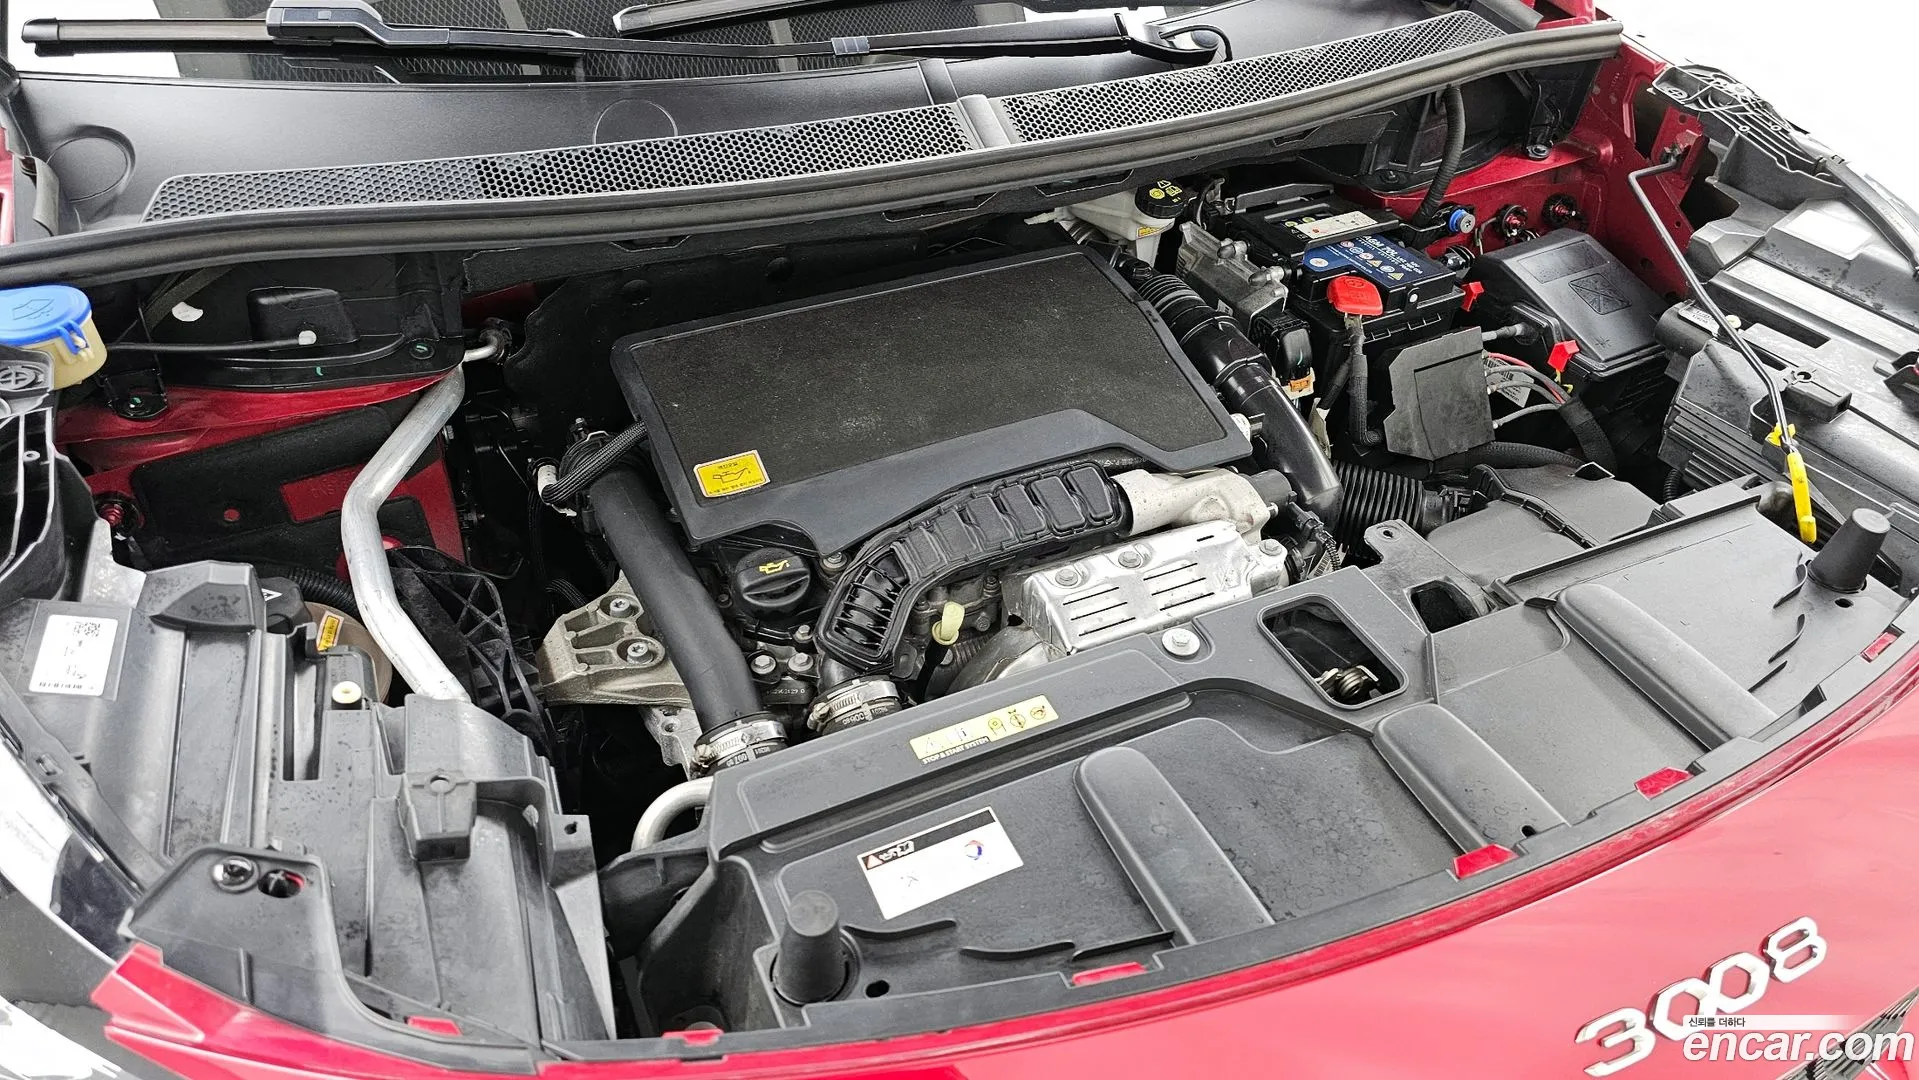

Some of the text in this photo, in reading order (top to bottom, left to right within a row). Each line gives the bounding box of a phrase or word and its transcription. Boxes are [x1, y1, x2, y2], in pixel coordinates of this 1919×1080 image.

[1363, 236, 1384, 247] AGM
[922, 754, 939, 765] STOP
[945, 746, 965, 756] START
[964, 737, 989, 748] SYSTEM
[1574, 916, 1828, 1078] 3008
